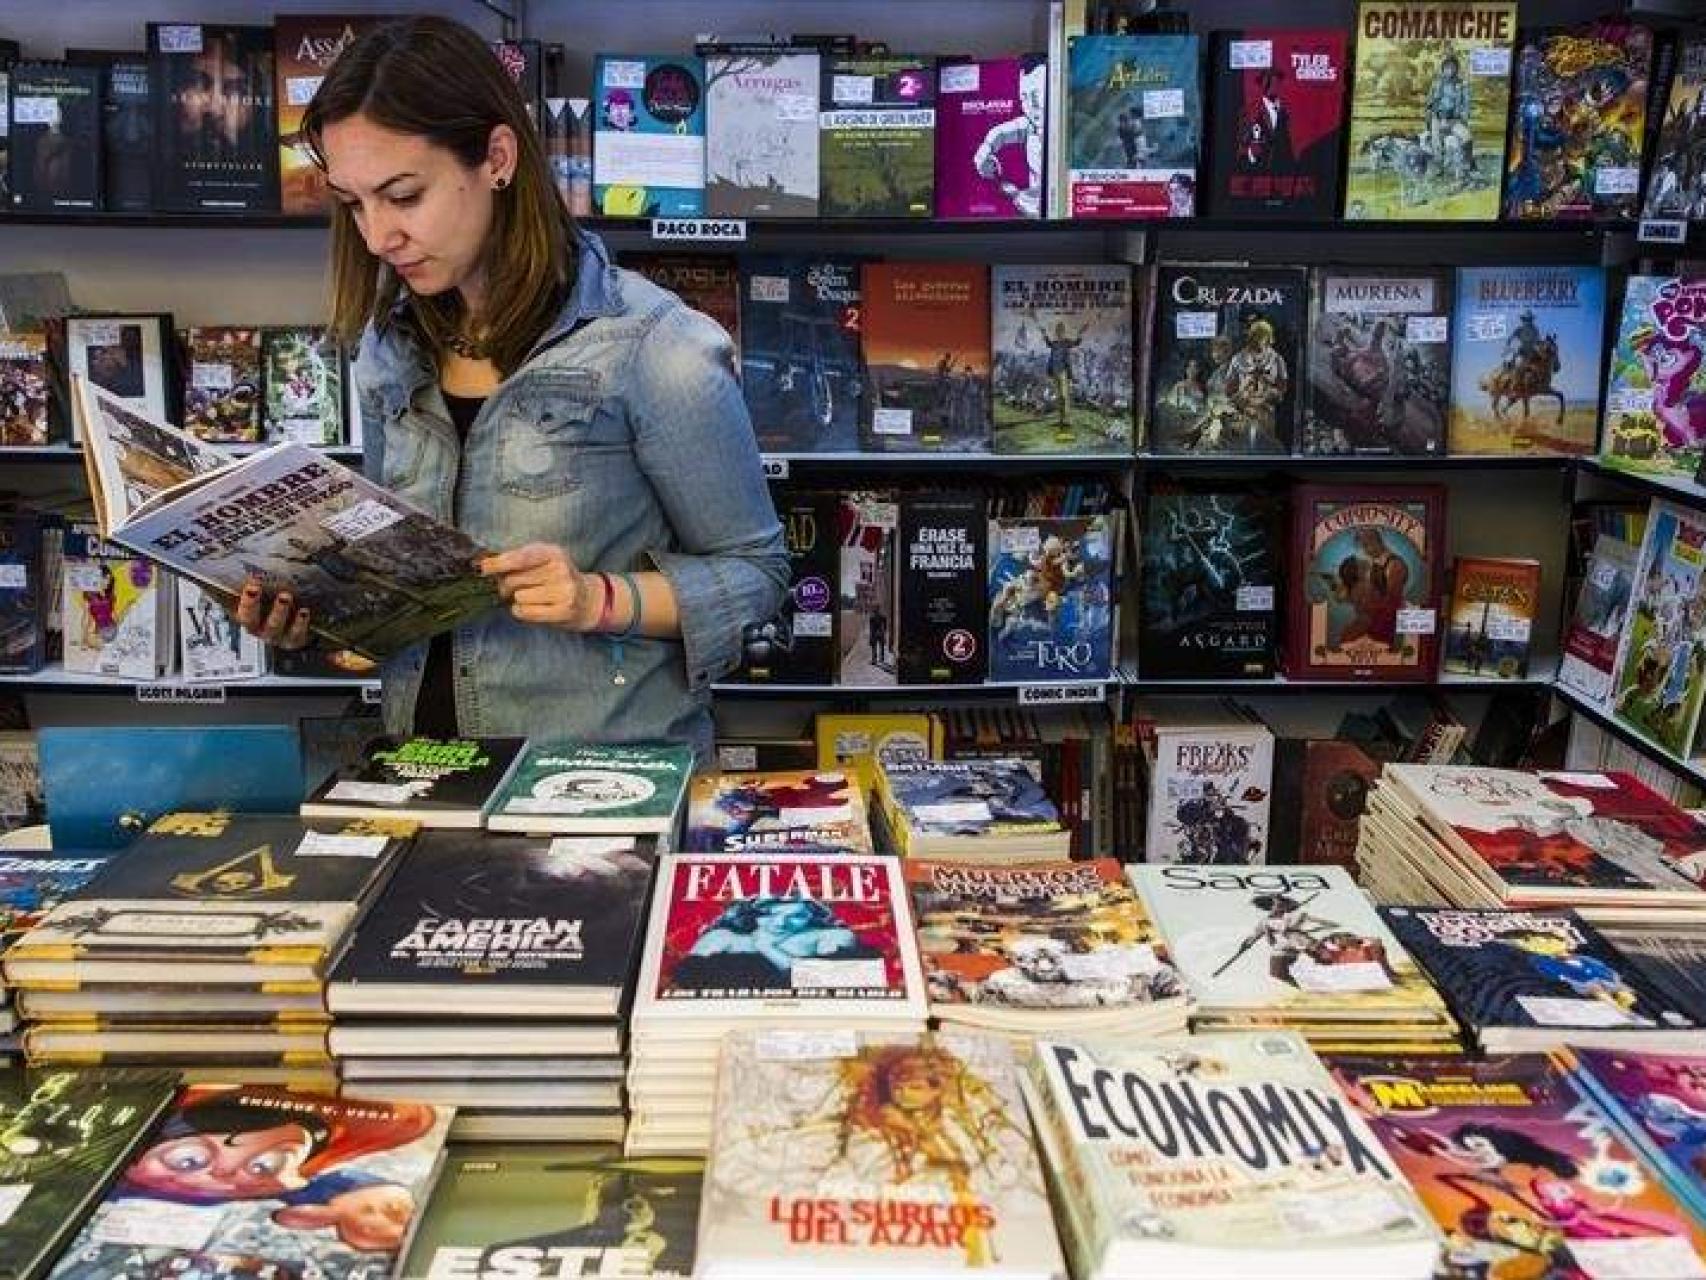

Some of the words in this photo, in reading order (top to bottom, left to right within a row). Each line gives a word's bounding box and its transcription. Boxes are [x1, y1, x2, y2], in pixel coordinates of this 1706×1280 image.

[1364, 10, 1510, 40] COMANCHE
[1291, 54, 1331, 67] TYLER
[729, 73, 801, 93] Arrugas
[1296, 67, 1337, 81] CROSS
[879, 111, 907, 125] GREEN
[909, 111, 933, 125] RIVER
[657, 222, 697, 235] PACO
[701, 222, 741, 235] ROCA
[1003, 280, 1030, 293] EL
[1035, 280, 1126, 293] HOMBRE
[1171, 275, 1284, 306] CRUZADA
[1335, 284, 1422, 300] MURENA
[1480, 278, 1578, 300] BLUEBERRY
[845, 309, 859, 328] 2
[151, 528, 203, 550] EL
[192, 461, 330, 531] HOMBRE
[910, 543, 937, 554] UNA
[938, 543, 956, 554] VEZ
[957, 543, 975, 554] EN
[910, 555, 975, 570] FRANCIA
[951, 635, 966, 655] 2
[1178, 634, 1267, 648] ASGARD
[1028, 640, 1093, 673] TURO
[139, 687, 172, 699] SCOTT
[174, 687, 224, 699] PILGRIM
[1065, 687, 1098, 699] INDIE
[724, 826, 843, 852] SUPERMAN
[683, 864, 880, 902] FATALE
[933, 864, 1098, 886] MUERTOS
[1161, 866, 1331, 894] Saga
[390, 950, 409, 959] EL
[489, 950, 510, 959] DE
[662, 988, 697, 999] LOS
[797, 988, 828, 999] DEL
[238, 1095, 314, 1112] ENRIQUE
[321, 1105, 340, 1117] V.
[1209, 1166, 1233, 1181] LA
[769, 1196, 841, 1223] LOS
[850, 1199, 996, 1228] SURCOS
[789, 1217, 855, 1245] DEL
[870, 1219, 967, 1249] AZAR
[428, 1246, 658, 1280] ESTE
